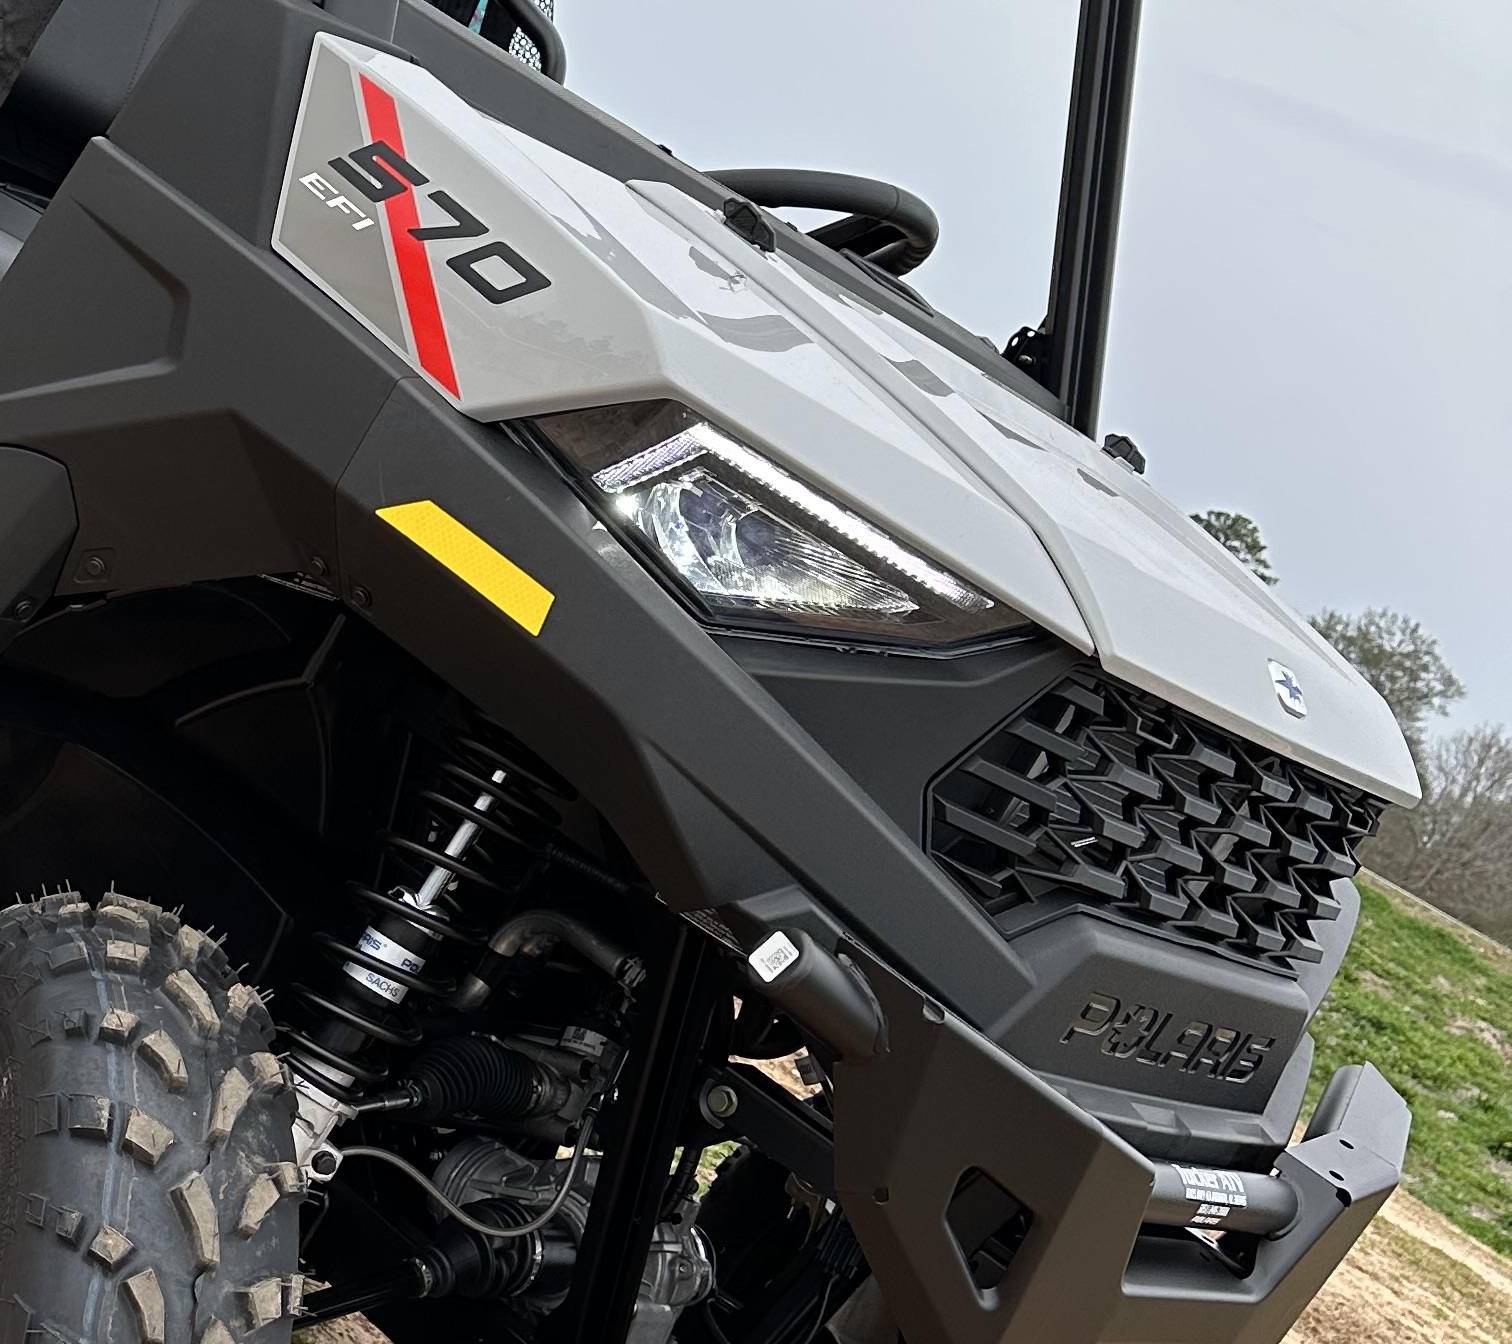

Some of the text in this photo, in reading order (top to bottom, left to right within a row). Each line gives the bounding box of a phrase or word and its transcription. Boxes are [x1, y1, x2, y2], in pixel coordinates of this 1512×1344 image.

[298, 172, 375, 231] EFI
[327, 140, 552, 305] 570
[366, 972, 400, 998] SACHS
[1059, 991, 1276, 1084] POLARIS
